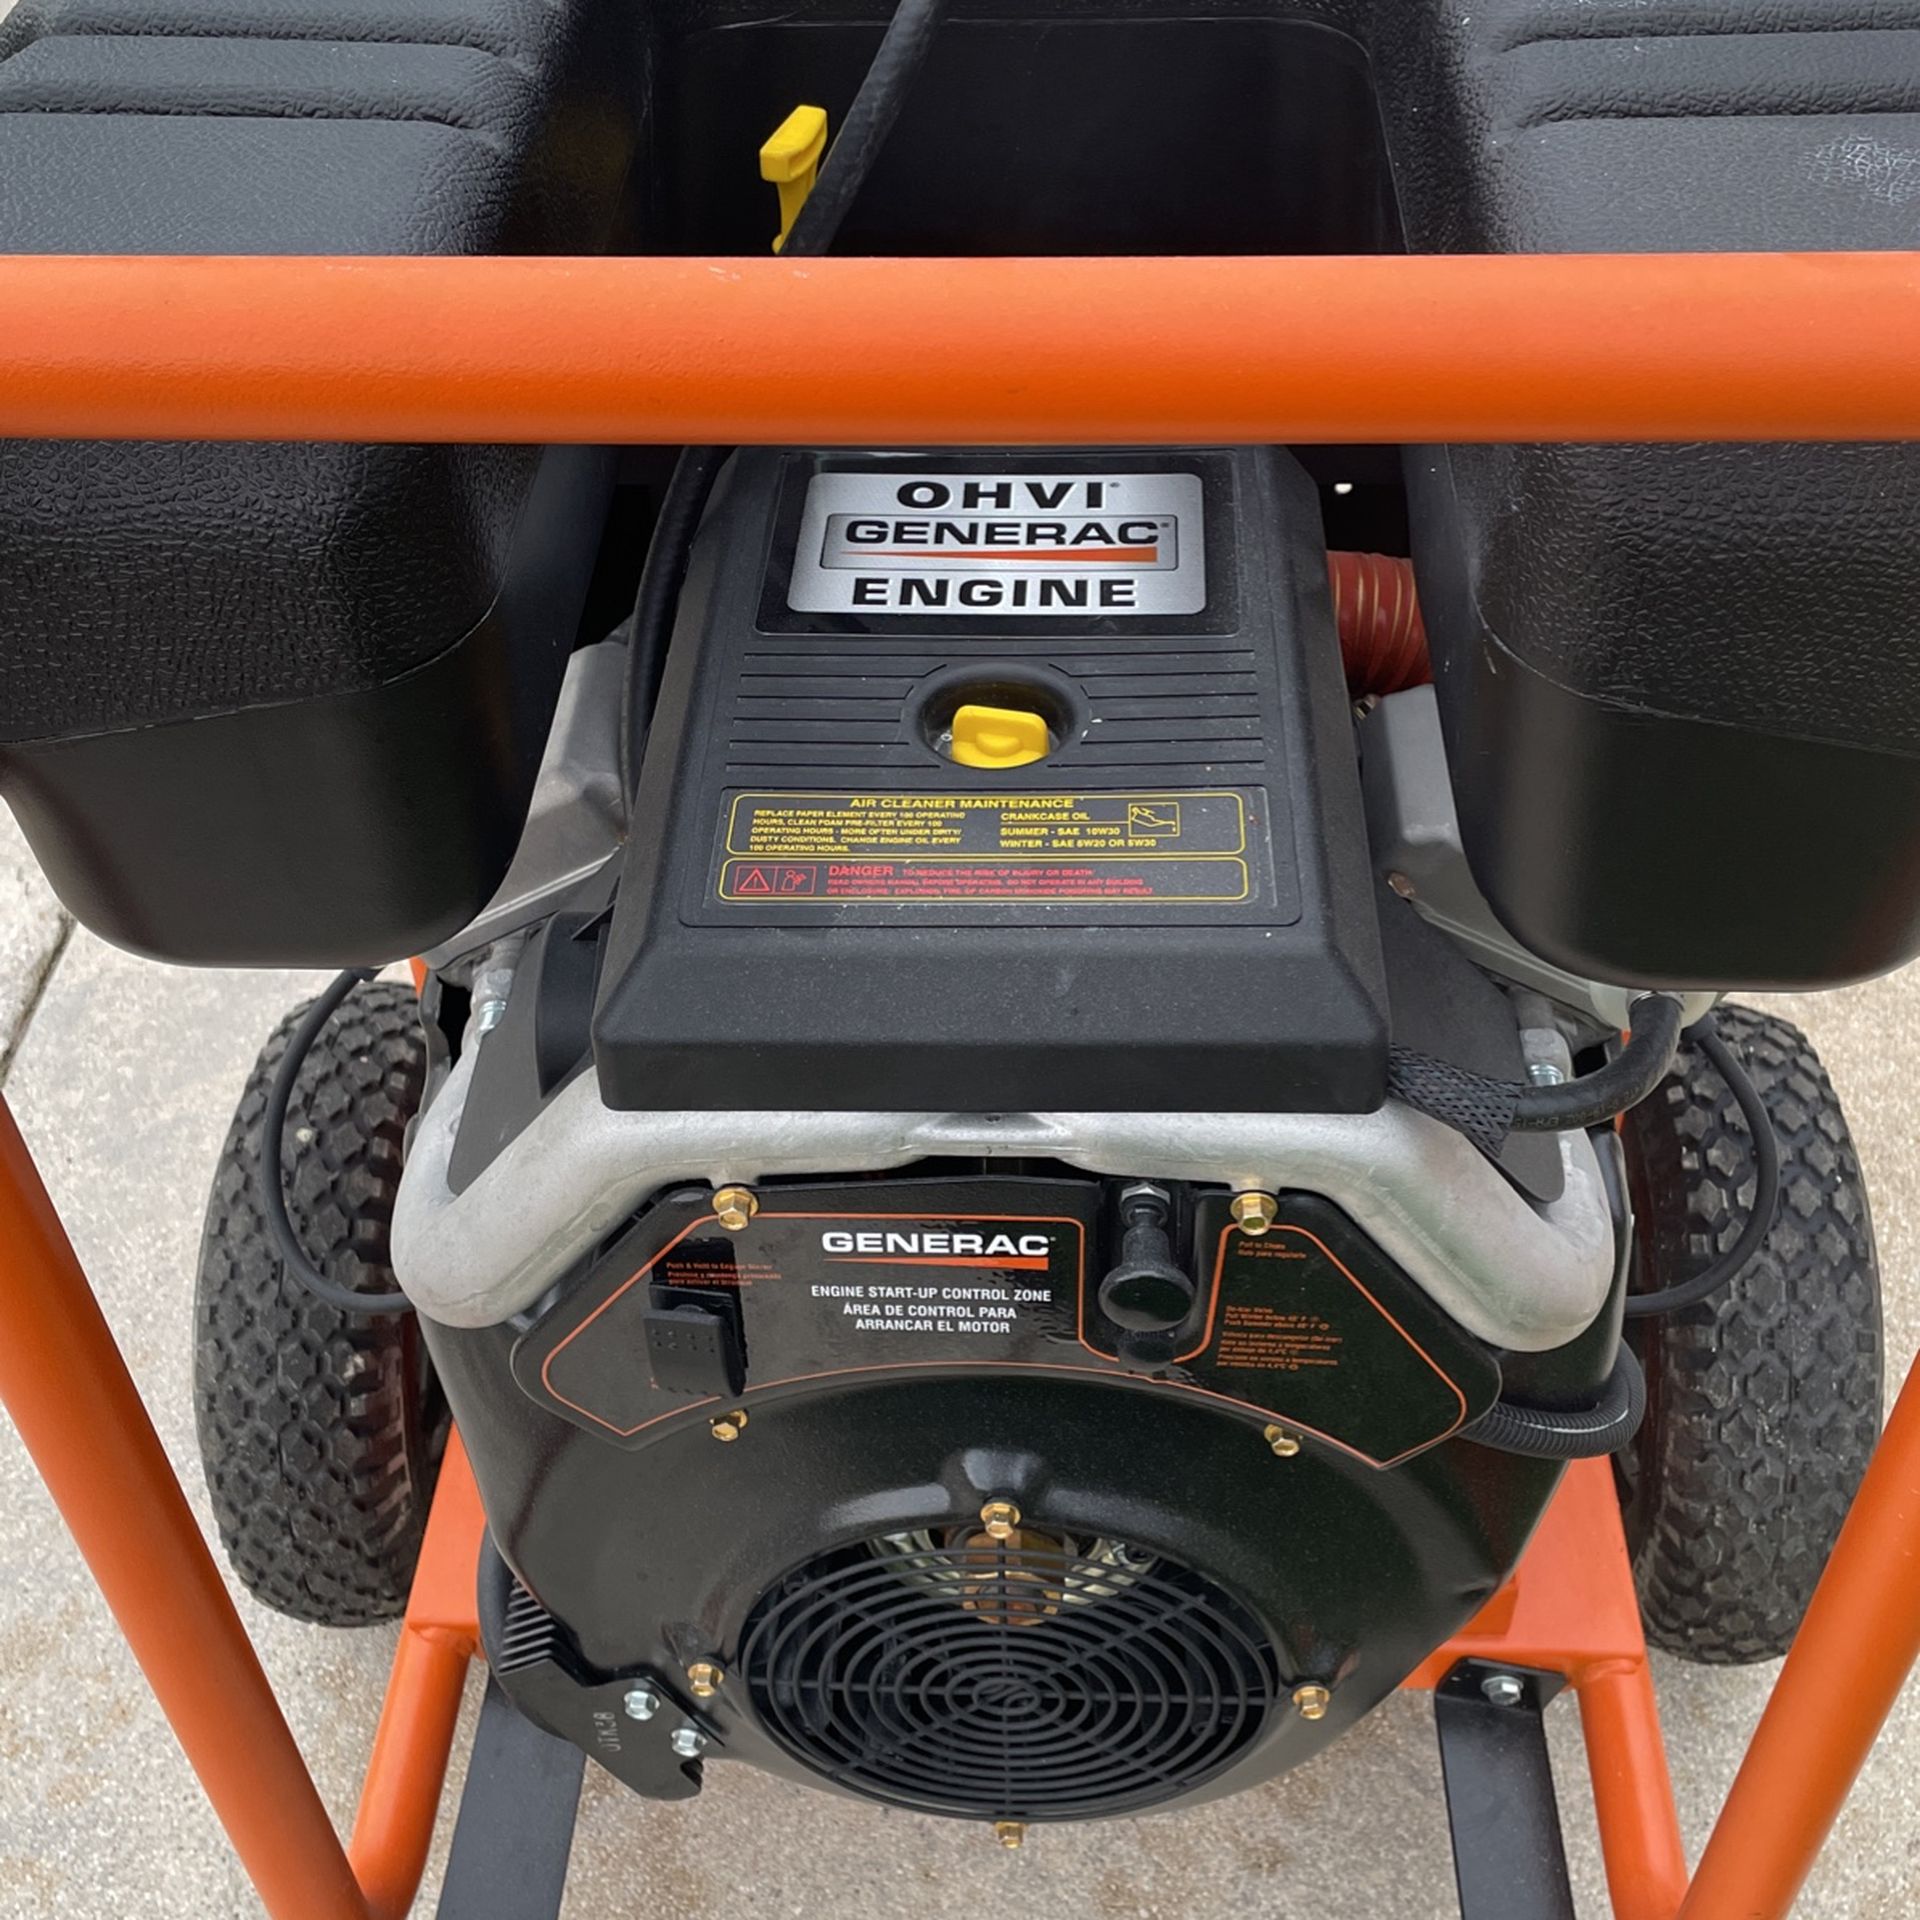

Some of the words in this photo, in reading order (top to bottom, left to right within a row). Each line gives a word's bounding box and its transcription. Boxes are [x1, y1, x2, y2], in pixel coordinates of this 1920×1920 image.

[896, 481, 1104, 509] OHVI
[845, 520, 1160, 546] GENERAC
[852, 577, 1137, 607] ENGINE
[849, 798, 877, 809] AIR
[880, 798, 956, 809] CLEANER
[960, 798, 1075, 809] MAINTENANCE
[754, 809, 795, 817] REPLACE
[796, 810, 824, 818] PAPER
[826, 810, 867, 819] ELEMENT
[868, 811, 898, 819] EVERY
[915, 811, 966, 820] OPERATING
[1000, 812, 1070, 821] CRANKCASE
[1071, 812, 1091, 821] OIL
[787, 818, 817, 826] CLEAN
[818, 819, 844, 827] FOAM
[896, 820, 926, 828] EVERY
[751, 827, 801, 835] OPERATING
[802, 827, 834, 835] HOURS
[840, 827, 867, 836] MORE
[868, 828, 898, 836] OFTEN
[900, 828, 931, 836] UNDER
[1000, 827, 1049, 836] SUMMER
[1057, 827, 1081, 836] SAE
[1086, 827, 1121, 836] 10W30
[840, 836, 878, 844] CHANGE
[879, 837, 913, 845] ENGINE
[914, 837, 930, 845] OIL
[931, 837, 962, 845] EVERY
[999, 839, 1043, 848] WINTER
[1051, 839, 1075, 848] SAE
[1108, 839, 1125, 848] OR
[1127, 838, 1157, 848] 5W30
[765, 844, 815, 852] OPERATING
[828, 865, 894, 876] DANGER
[821, 1231, 1050, 1256] GENERAC
[811, 1285, 864, 1298] ENGINE
[868, 1286, 938, 1299] START-UP
[941, 1287, 1010, 1301] CONTROL
[1013, 1289, 1052, 1302] ZONE
[843, 1301, 882, 1316] ÁREA
[884, 1304, 904, 1317] DE
[907, 1305, 976, 1318] CONTROL
[978, 1307, 1017, 1319] PARA
[855, 1318, 934, 1332] ARRANCAR
[937, 1320, 955, 1333] EL
[958, 1321, 1011, 1334] MOTOR
